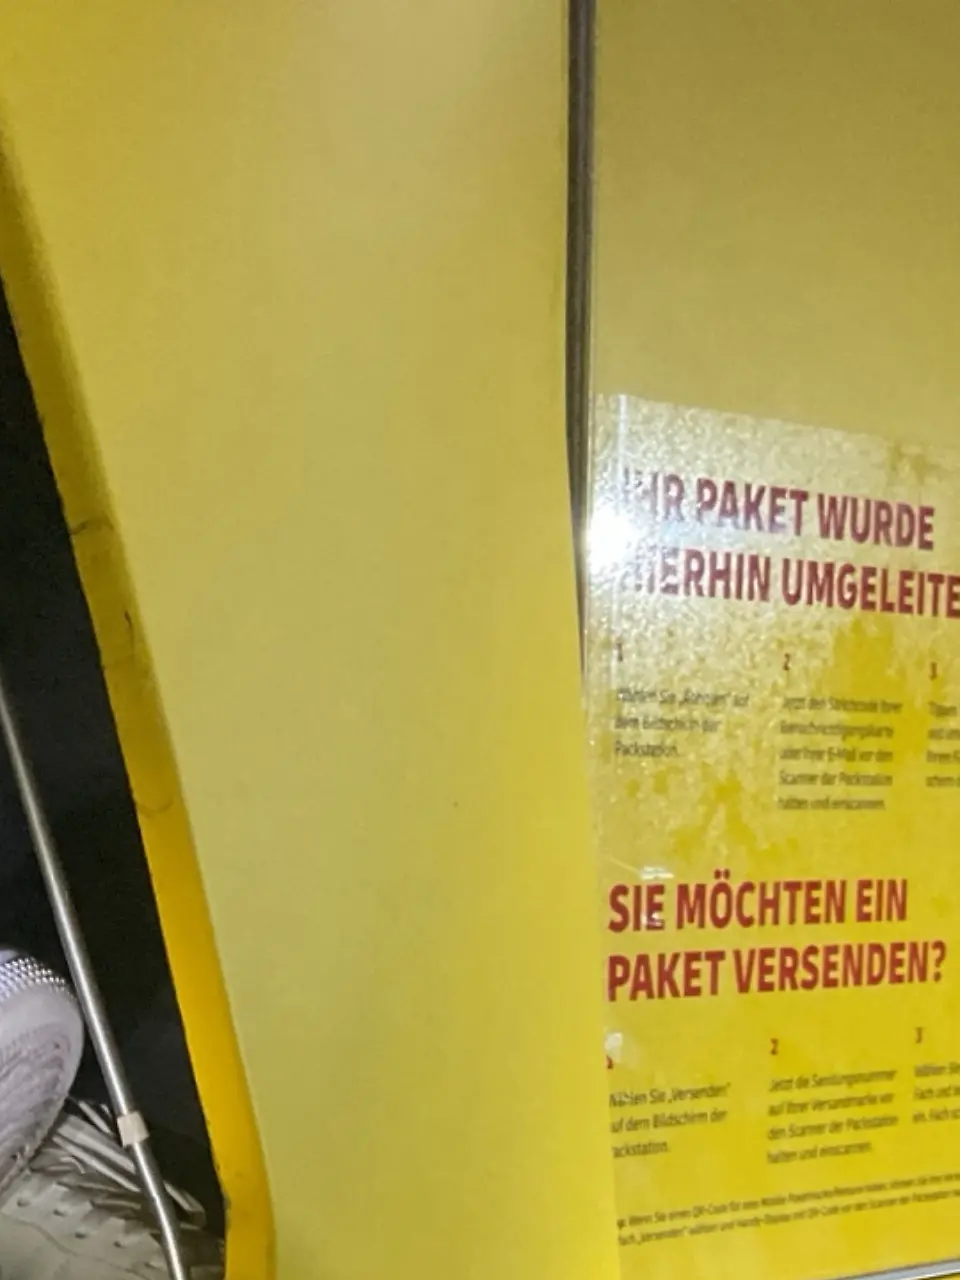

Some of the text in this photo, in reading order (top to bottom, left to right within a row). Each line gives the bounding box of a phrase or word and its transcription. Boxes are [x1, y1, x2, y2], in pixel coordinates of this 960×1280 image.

[696, 477, 809, 536] PAKET
[817, 492, 935, 551] WURDE
[608, 869, 909, 933] SIE MÖCHTEN EIN
[607, 940, 947, 1003] PAKET VERSENDEN?
